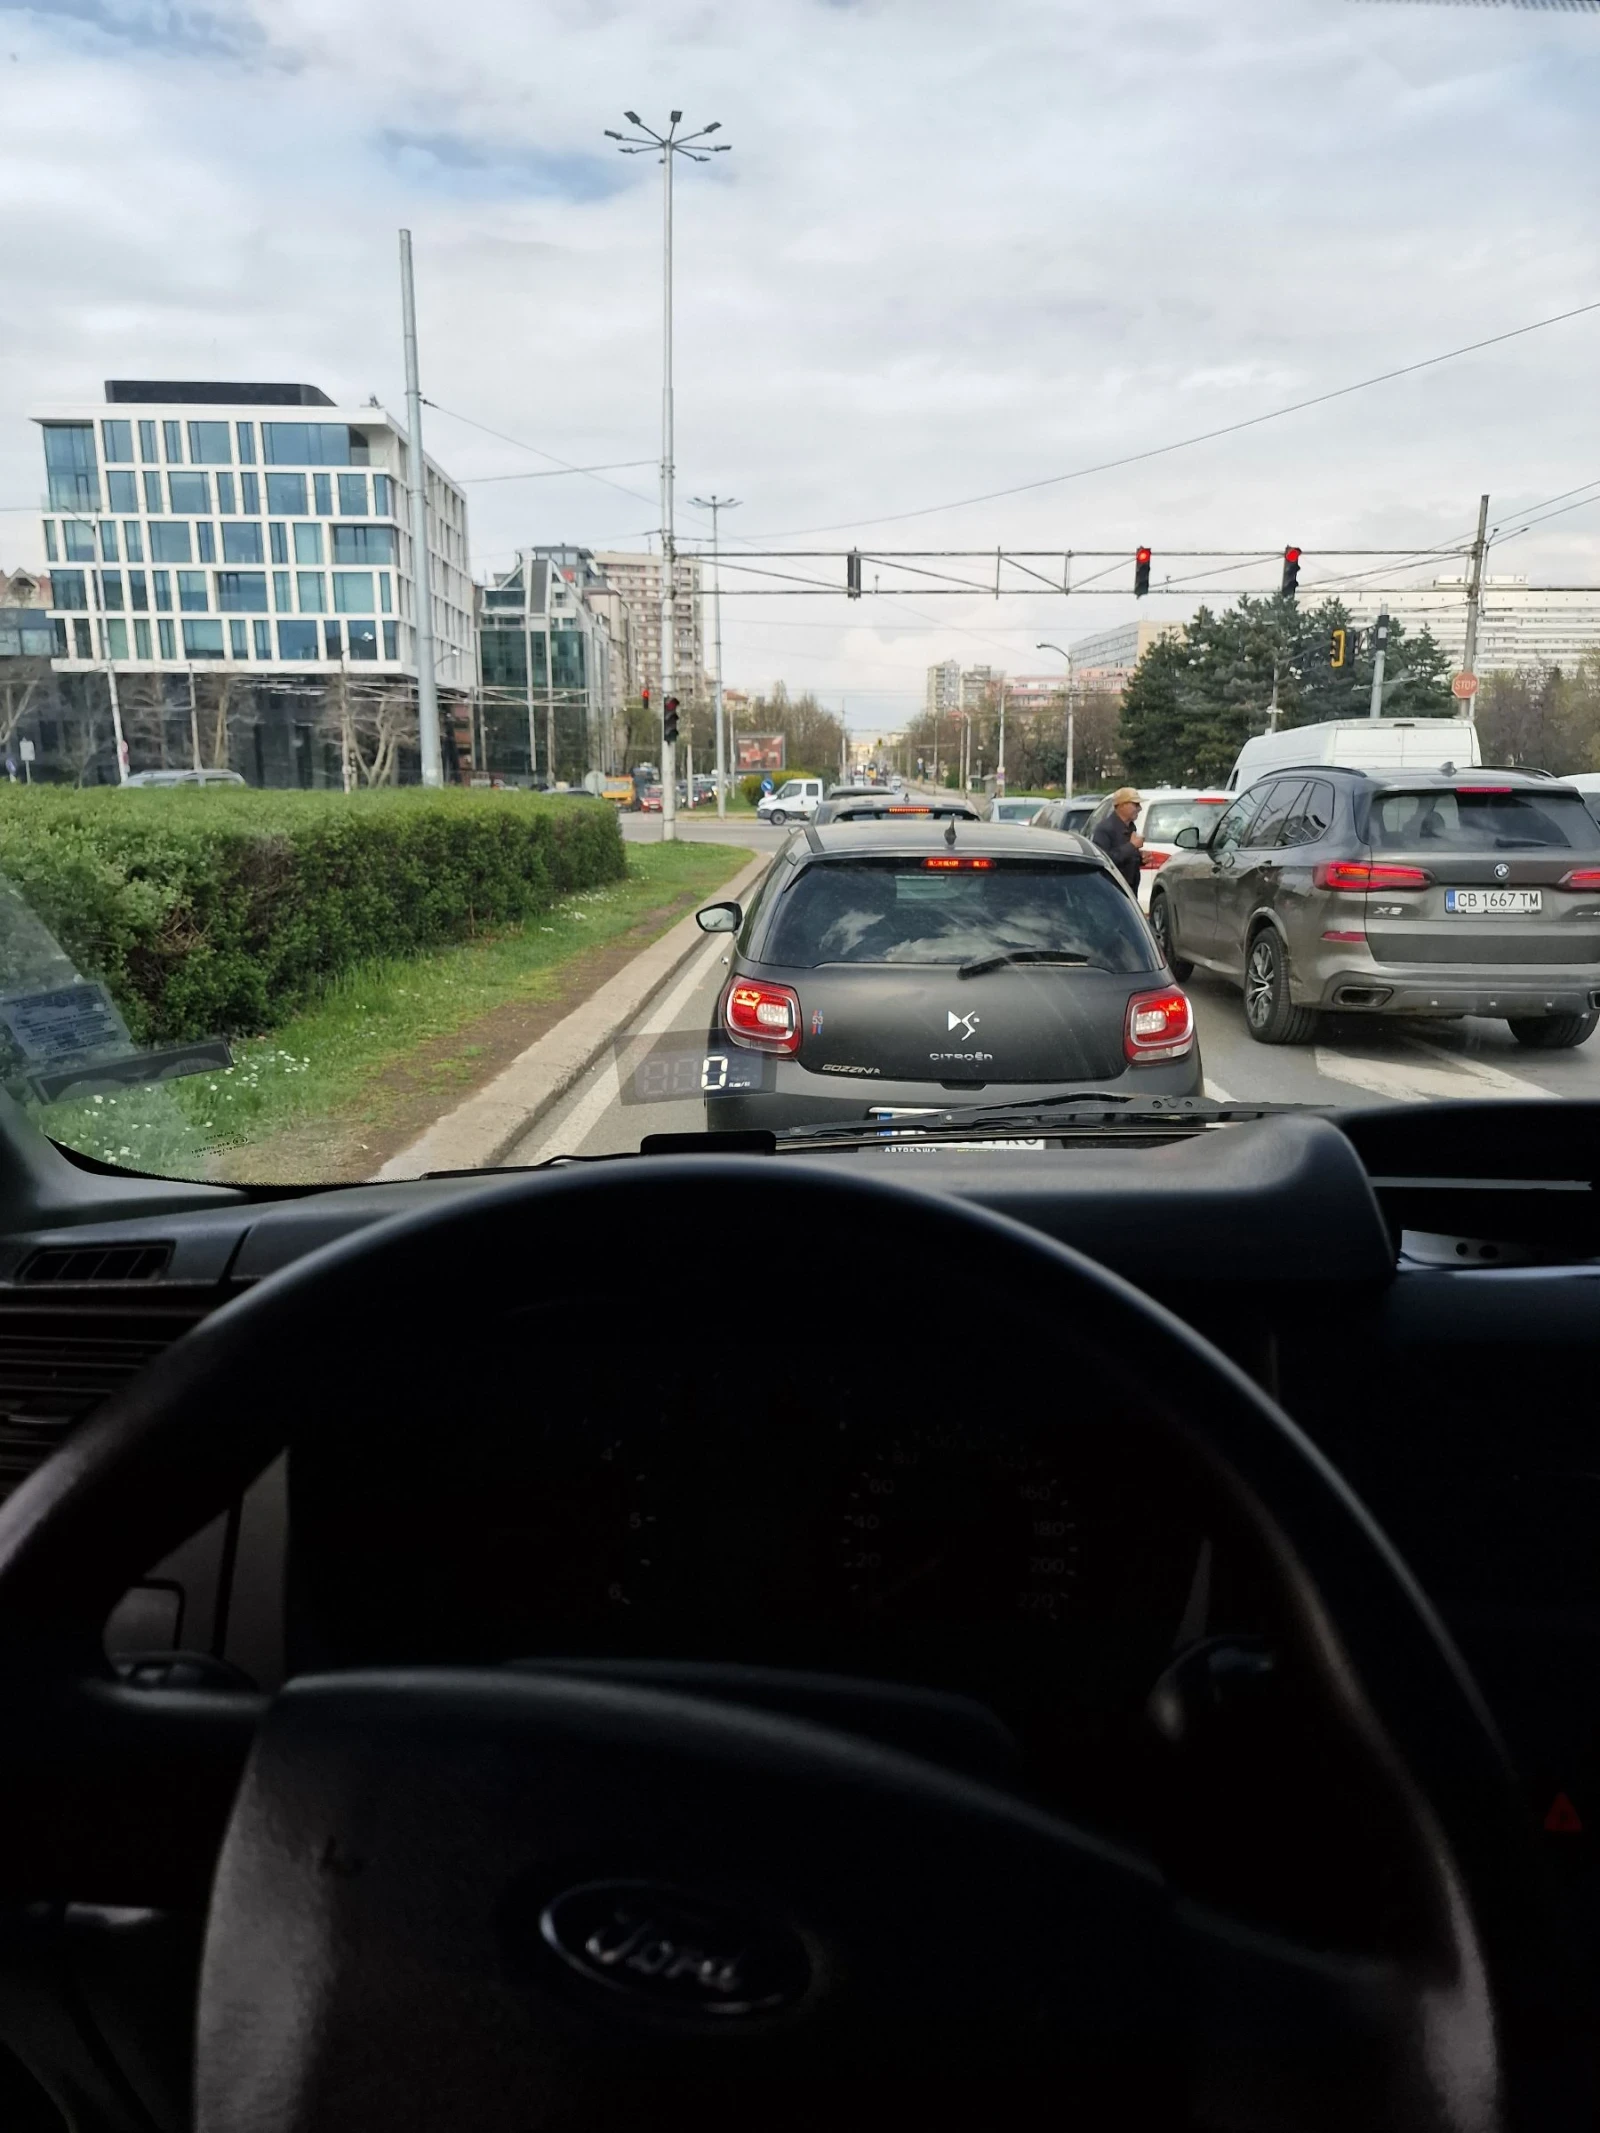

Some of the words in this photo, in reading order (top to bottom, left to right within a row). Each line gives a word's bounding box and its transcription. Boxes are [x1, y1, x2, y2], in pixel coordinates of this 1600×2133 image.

[1455, 680, 1477, 690] STOP
[1458, 893, 1478, 907] CB
[1482, 893, 1516, 907] 1667
[1519, 893, 1539, 907] TM
[812, 1015, 824, 1025] 53
[701, 1055, 728, 1090] 0
[821, 1063, 874, 1075] GOZZINI
